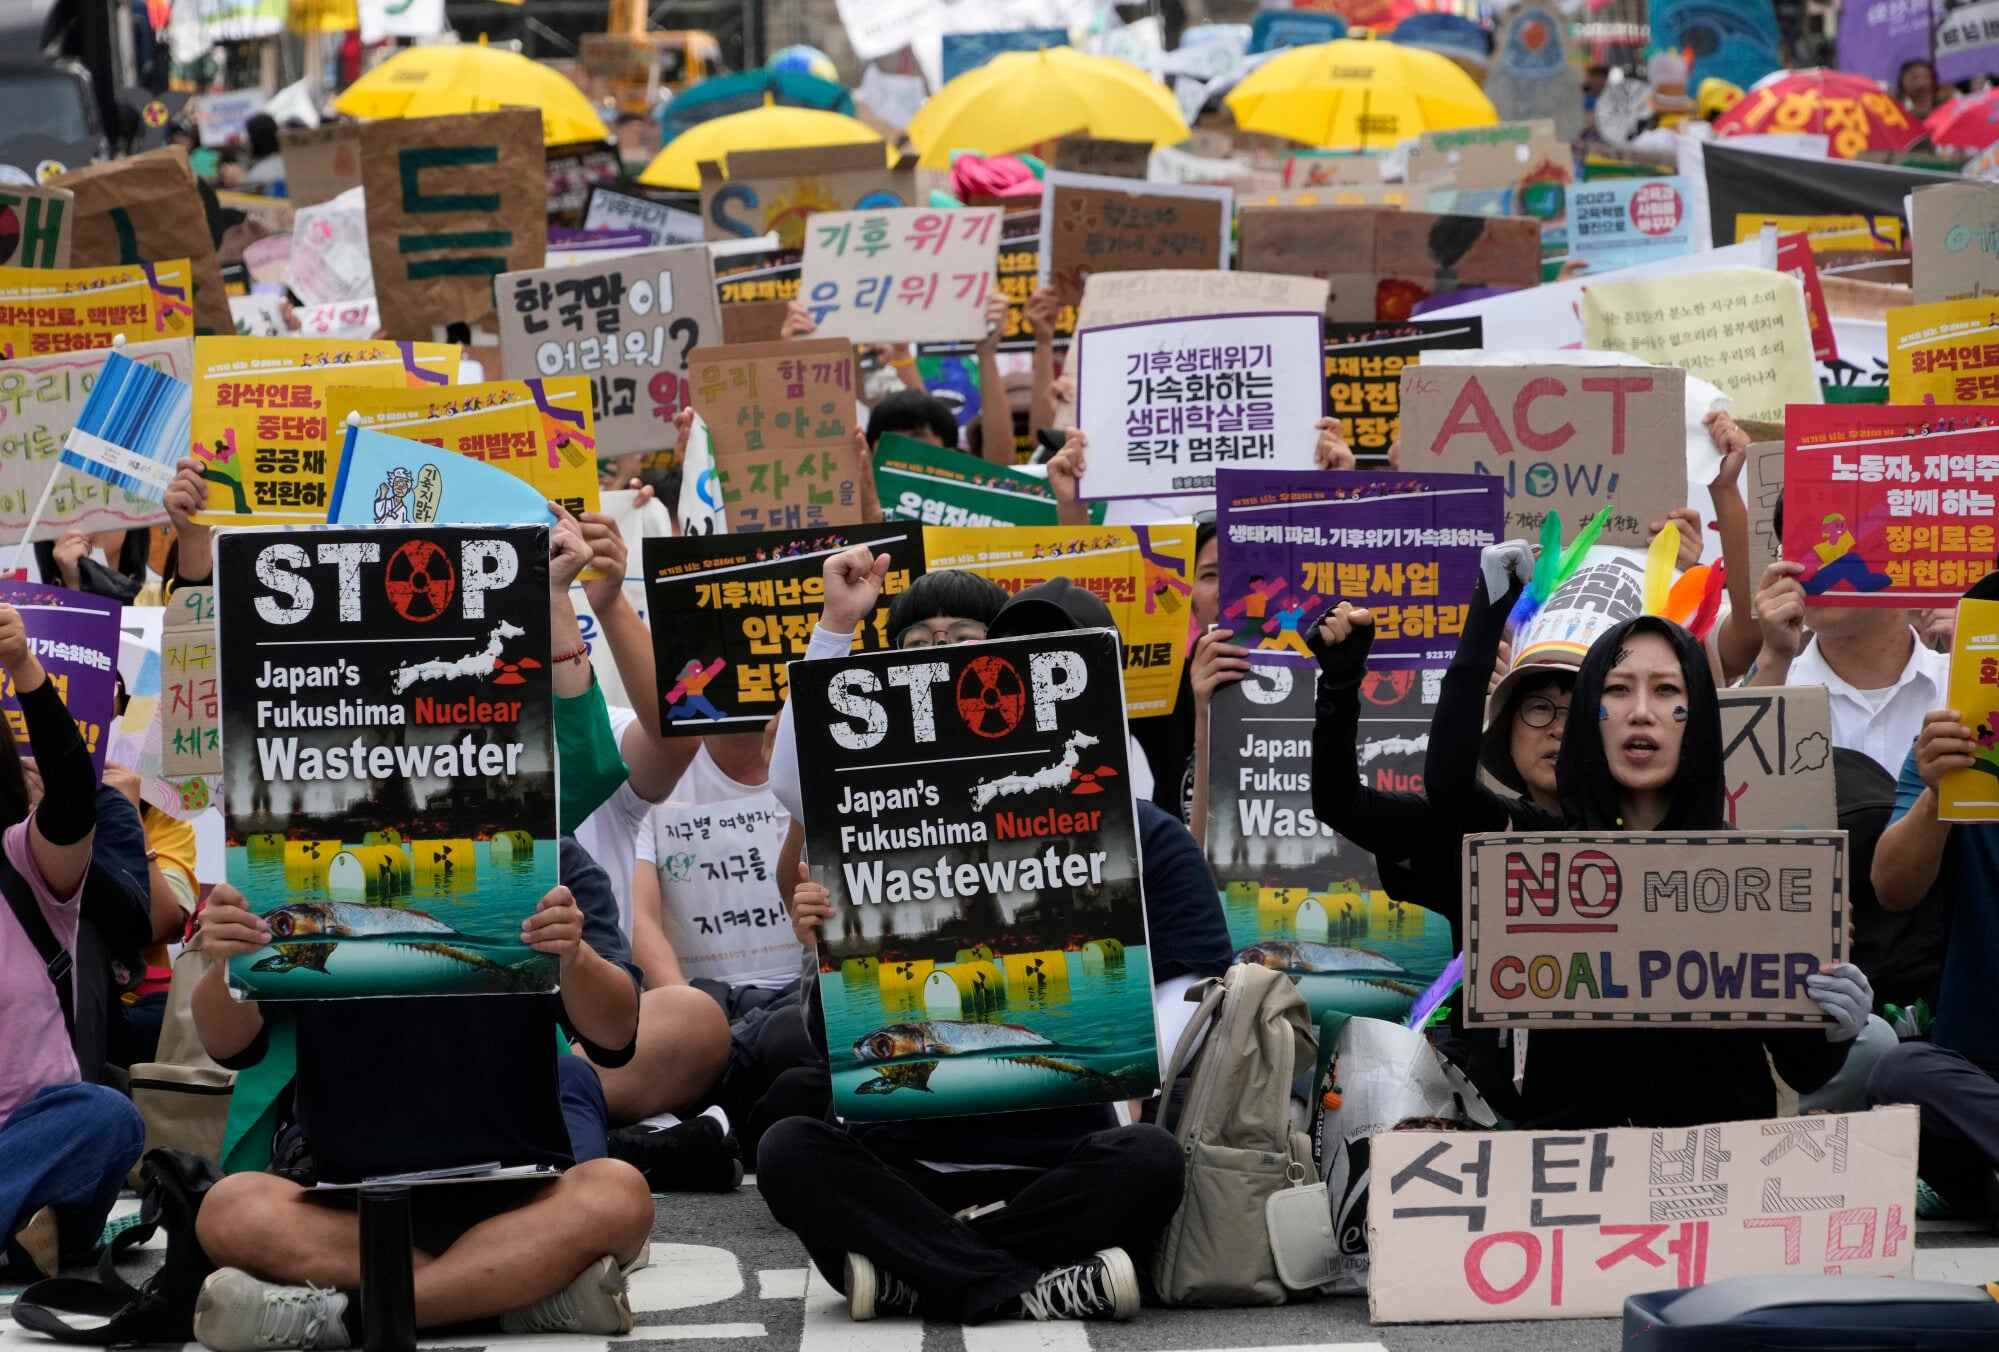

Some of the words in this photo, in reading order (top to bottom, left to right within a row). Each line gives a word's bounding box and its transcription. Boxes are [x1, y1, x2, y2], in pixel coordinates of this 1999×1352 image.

[1575, 192, 1616, 205] 2023
[816, 217, 891, 257] 기후
[905, 213, 996, 256] 위기
[86, 303, 148, 326] 핵발전
[514, 270, 673, 335] 한국말이
[807, 275, 893, 326] 우리
[897, 271, 990, 311] 위기
[31, 332, 113, 353] 중단하고
[537, 317, 700, 376] 어려워?
[1126, 345, 1273, 376] 기후생태위기
[216, 382, 322, 411] 화석연료,
[698, 361, 759, 403] 우리
[777, 357, 851, 398] 함께
[1127, 372, 1274, 405] 가속화하는
[736, 401, 846, 451] 살아요
[1126, 402, 1275, 438] 생태학살을
[1430, 374, 1654, 457] ACT
[1127, 439, 1180, 465] 즉각
[1188, 434, 1275, 463] 멈춰라!
[1831, 453, 1921, 482] 노동자,
[1473, 460, 1620, 500] NOW!
[1228, 524, 1282, 545] 생태계
[1329, 527, 1402, 549] 기후위기
[1403, 528, 1495, 548] 가속화하는
[1885, 525, 1997, 554] 정의로운
[253, 539, 520, 625] STOP
[1301, 561, 1440, 598] 개발사업
[38, 639, 112, 672] 가속화하는
[167, 643, 216, 673] 지구
[256, 658, 361, 695] Japan's
[257, 698, 406, 728] Fukushima
[415, 696, 523, 725] Nuclear
[828, 650, 1089, 750] STOP
[256, 735, 524, 781] Wastewater
[836, 779, 941, 818] Japan's
[665, 815, 712, 842] 지구별
[840, 818, 988, 854] Fukushima
[995, 807, 1102, 841] Nuclear
[701, 847, 768, 884] 지구를
[843, 846, 1107, 907] Wastewater
[1505, 849, 1623, 919] NO
[1644, 867, 1812, 914] MORE
[693, 901, 788, 935] 지켜라!
[1490, 951, 1629, 1001] COAL
[1639, 950, 1822, 1001] POWER
[1463, 1219, 1711, 1307] 이제
